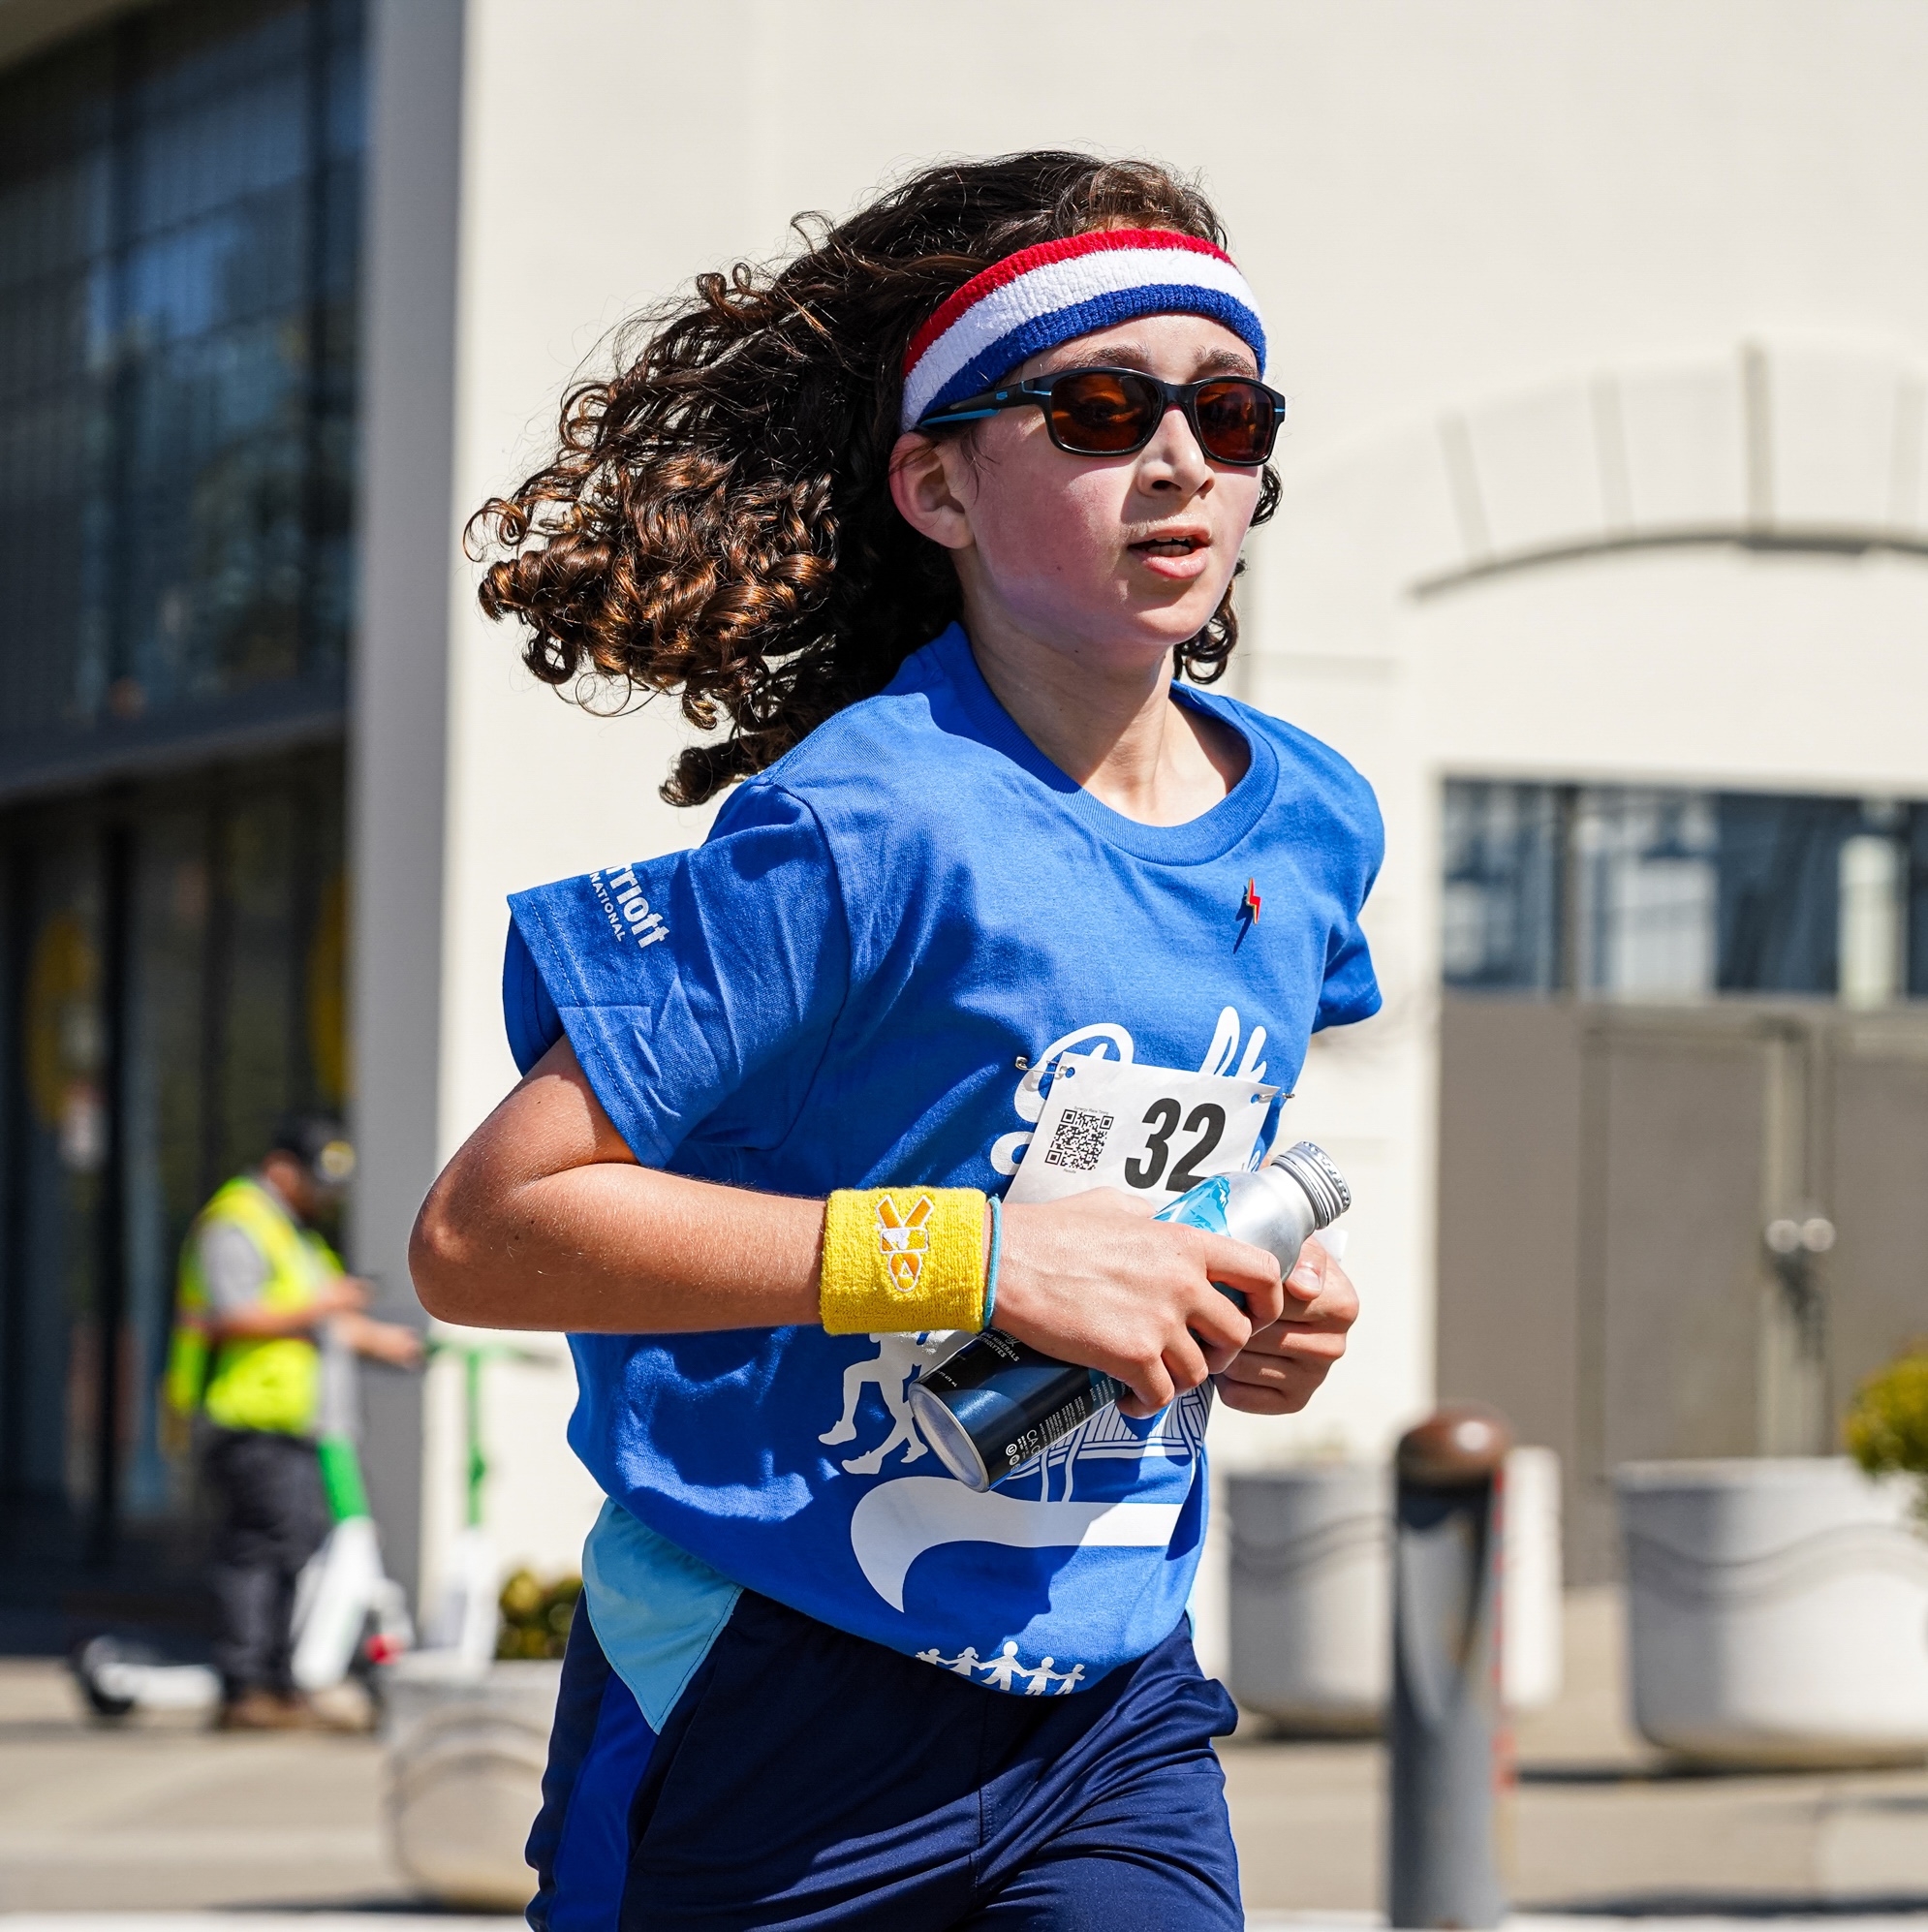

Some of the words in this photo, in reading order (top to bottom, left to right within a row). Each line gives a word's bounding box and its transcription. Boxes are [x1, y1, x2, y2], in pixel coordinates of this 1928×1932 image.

[1124, 1097, 1226, 1193] 32
[992, 1336, 1020, 1362] MINERALS
[1026, 1429, 1039, 1448] CA
